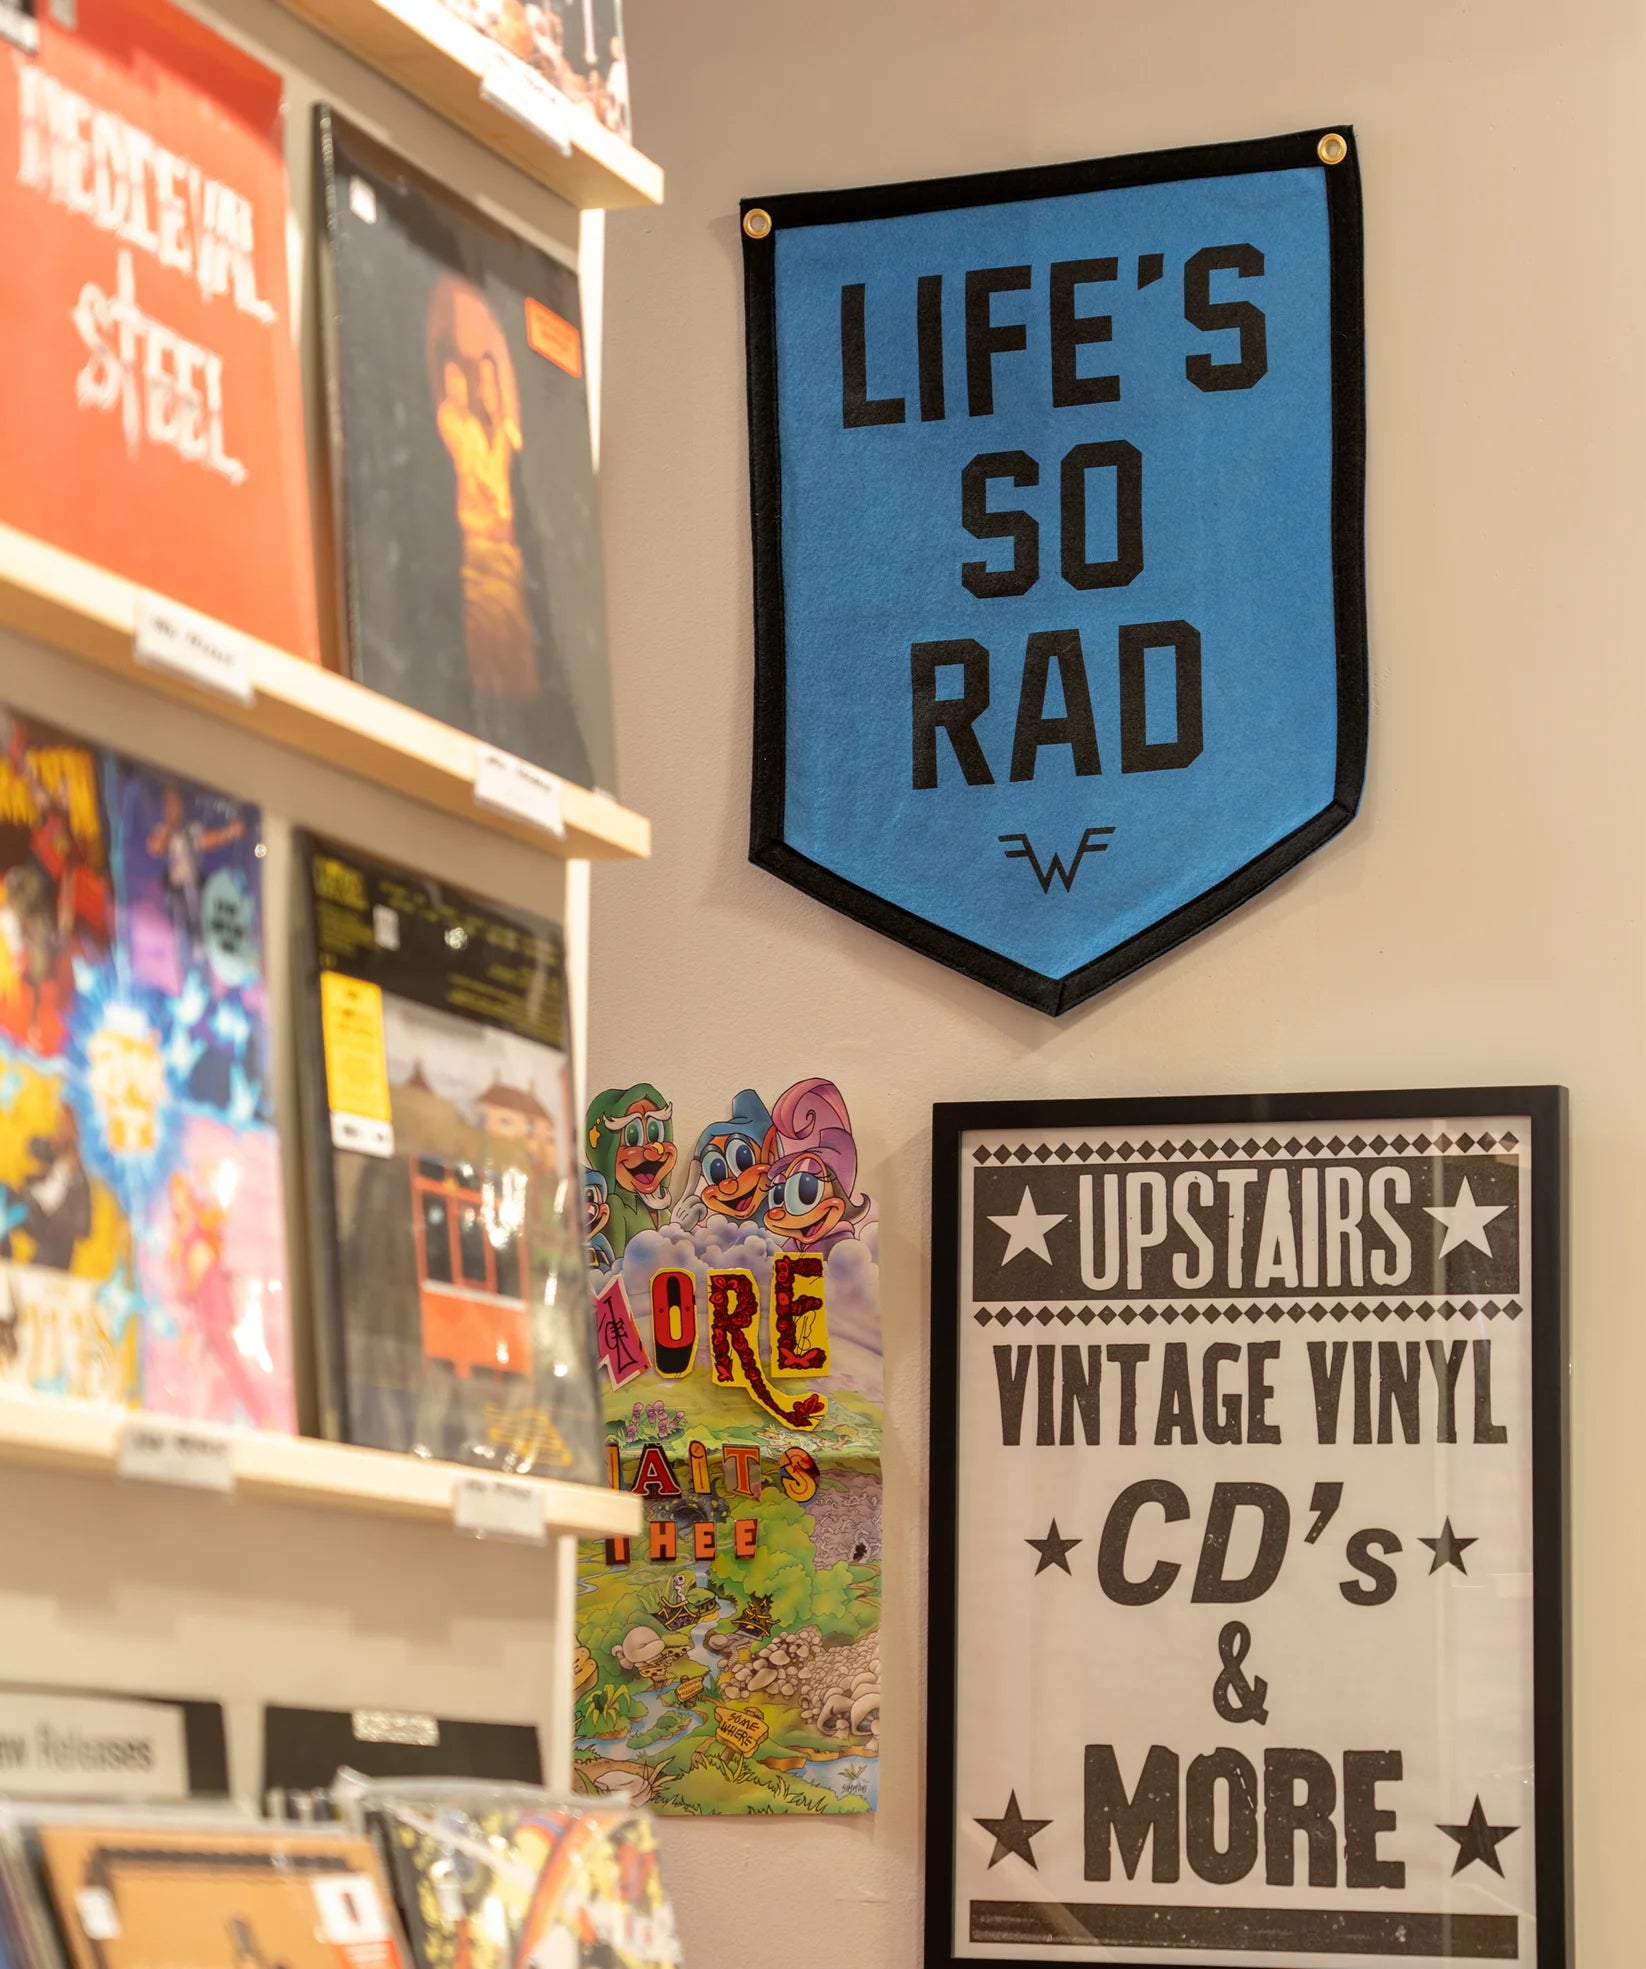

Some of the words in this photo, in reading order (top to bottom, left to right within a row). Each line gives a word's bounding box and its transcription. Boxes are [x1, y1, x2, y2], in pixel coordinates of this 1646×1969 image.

[840, 243, 1268, 430] LIFE'S
[961, 439, 1145, 600] SO
[910, 619, 1204, 790] RAD
[1078, 1165, 1413, 1291] UPSTAIRS
[992, 1340, 1283, 1447] VINTAGE
[1306, 1339, 1509, 1445] VINYL
[1096, 1478, 1404, 1607] CD's
[720, 1721, 754, 1748] WHERE
[727, 1712, 760, 1732] SOME
[1212, 1620, 1270, 1726] &
[1083, 1744, 1407, 1890] MORE
